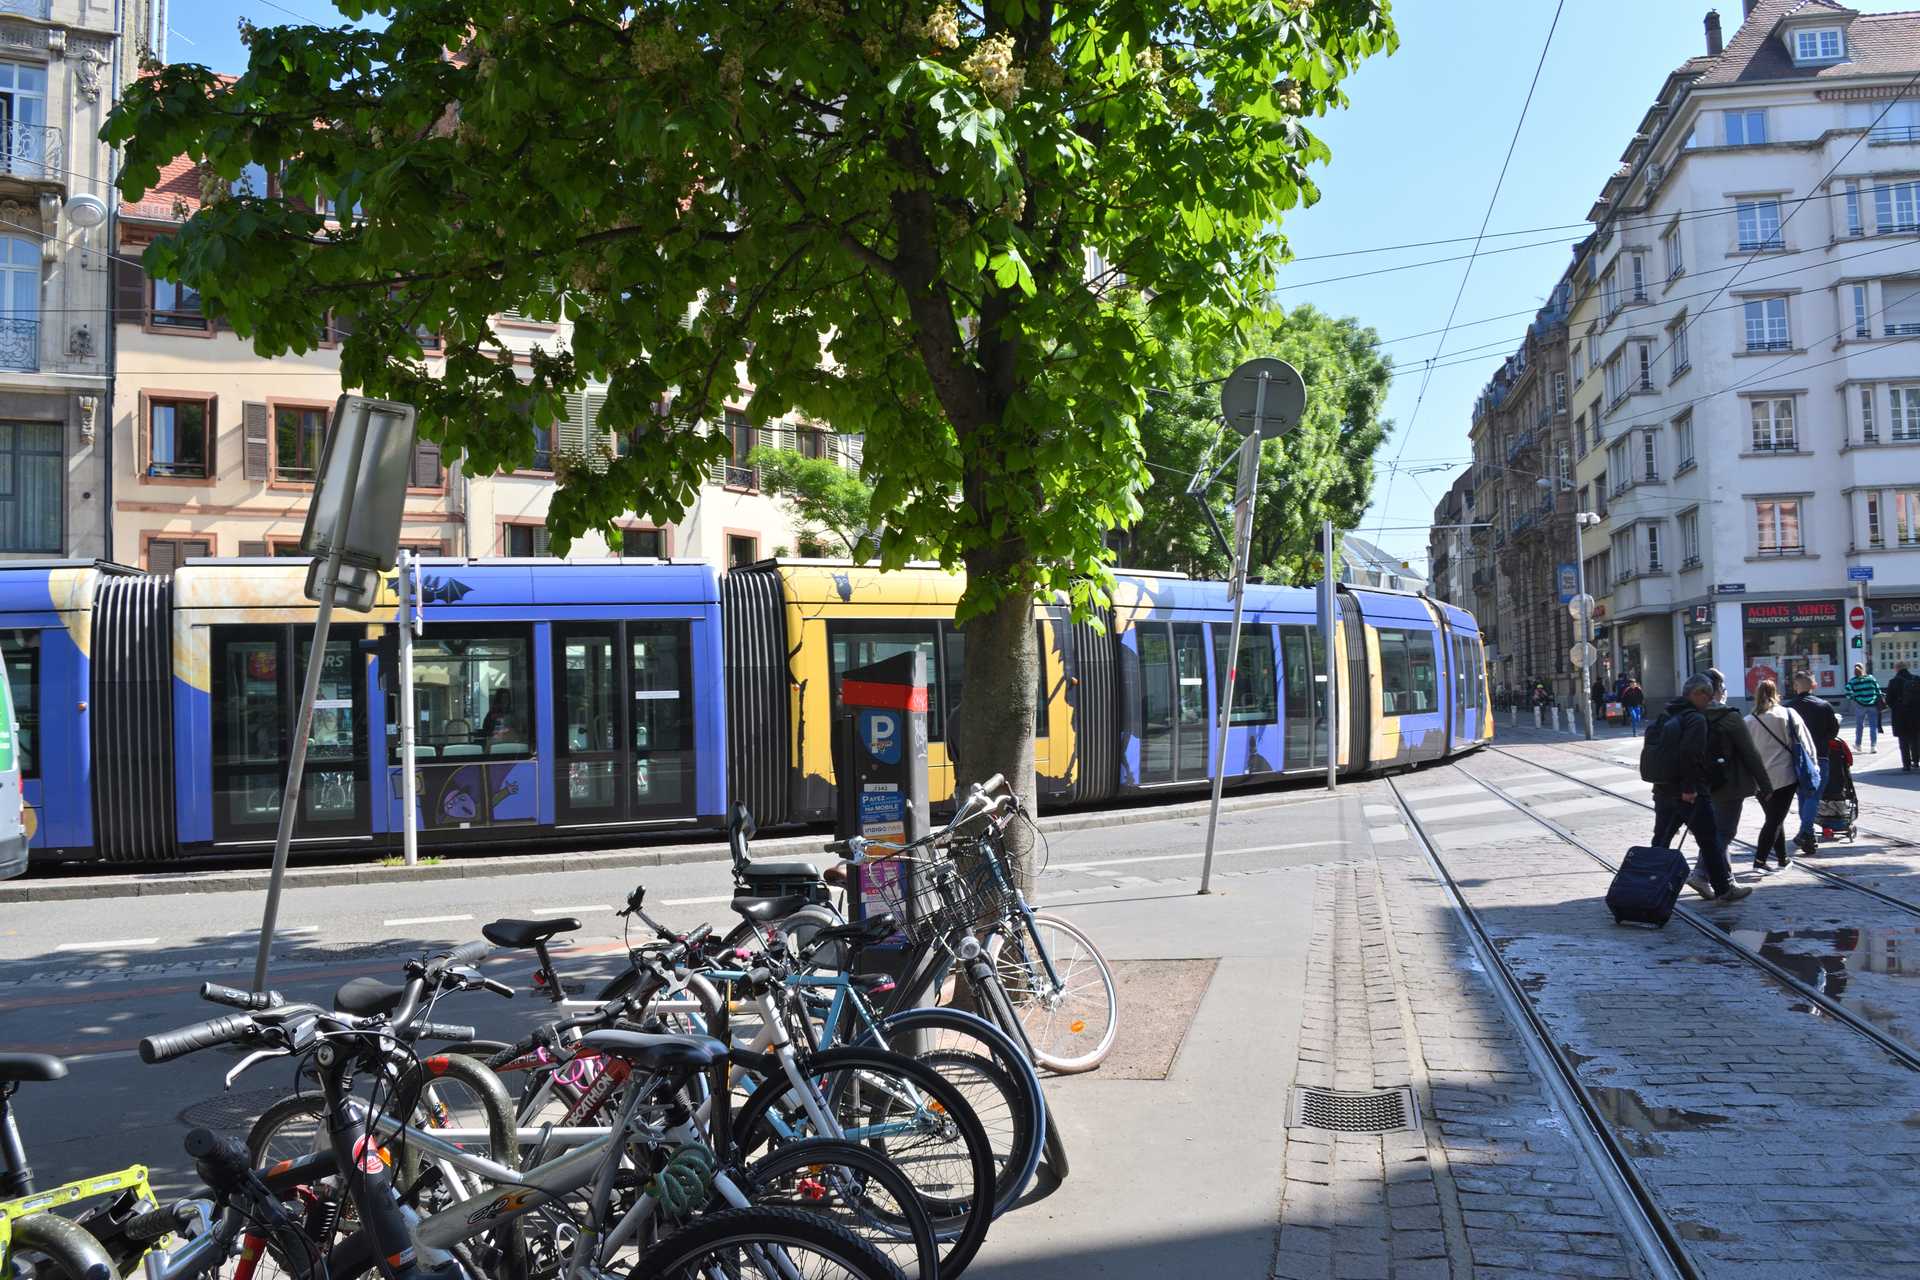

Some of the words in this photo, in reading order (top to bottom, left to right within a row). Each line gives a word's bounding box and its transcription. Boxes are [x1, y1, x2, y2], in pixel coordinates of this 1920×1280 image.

[1748, 605, 1789, 616] ACHATS
[1798, 603, 1837, 614] VENTES
[871, 715, 894, 753] P
[874, 803, 899, 811] MOBILE
[564, 1072, 615, 1128] DECATHLON
